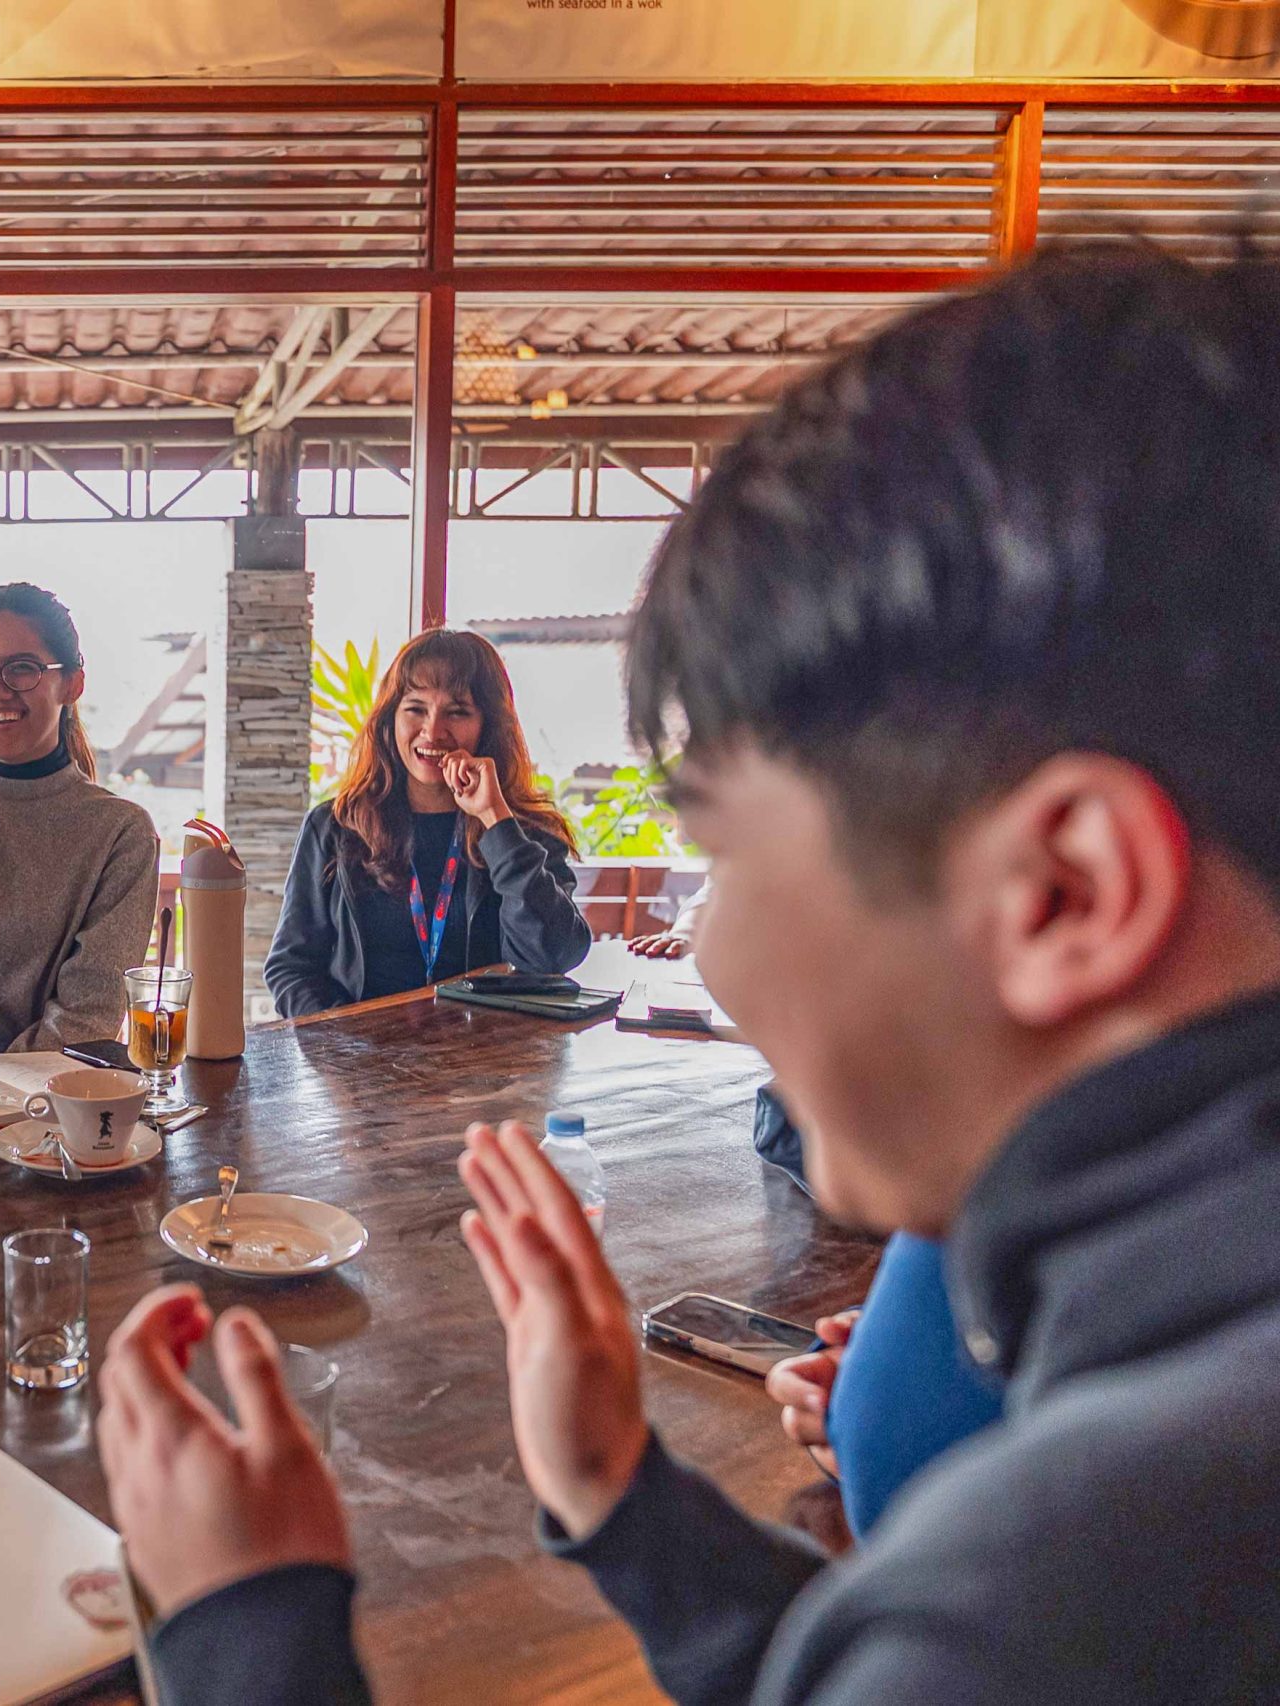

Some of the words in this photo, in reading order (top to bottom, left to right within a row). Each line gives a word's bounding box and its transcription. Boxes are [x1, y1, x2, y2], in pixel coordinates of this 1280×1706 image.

[527, 0, 554, 9] with
[558, 0, 606, 9] seafood
[638, 0, 663, 9] wok
